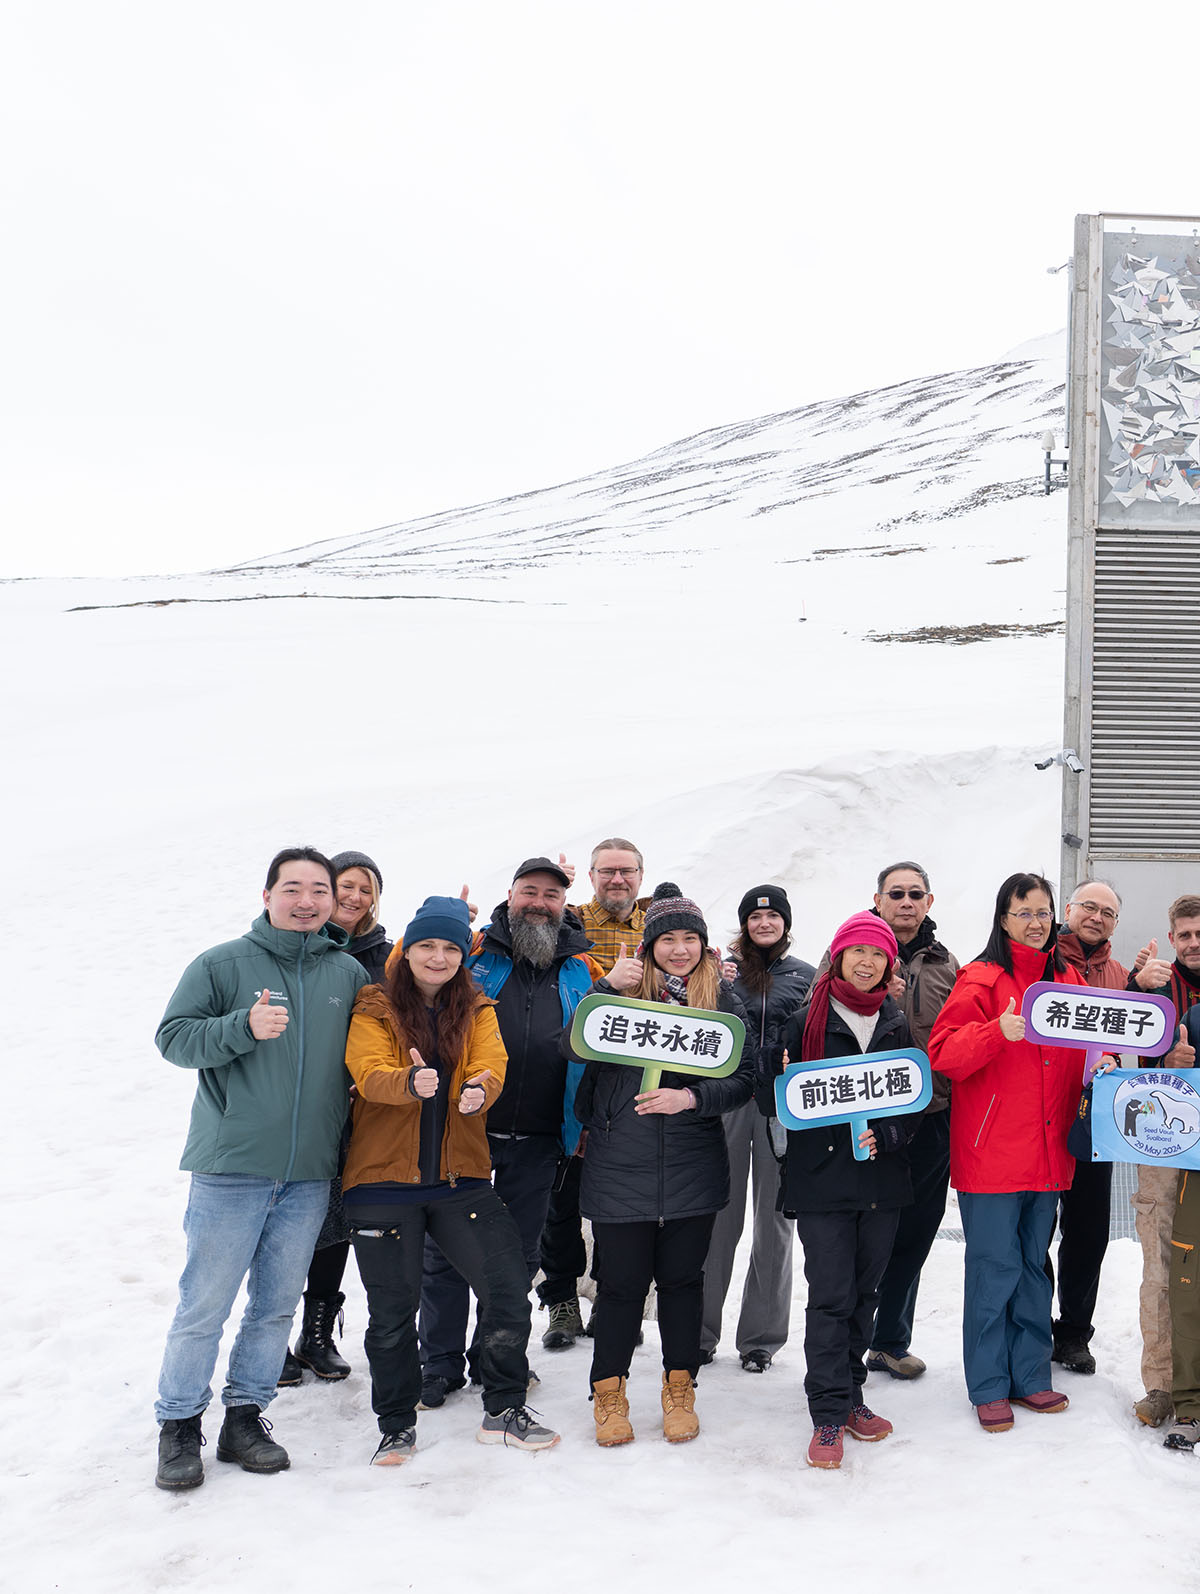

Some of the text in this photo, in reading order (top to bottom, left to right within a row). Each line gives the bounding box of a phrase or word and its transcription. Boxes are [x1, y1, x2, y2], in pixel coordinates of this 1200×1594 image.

[1046, 1000, 1155, 1037] 希望種子
[599, 1014, 723, 1059] 追求永續
[799, 1066, 912, 1110] 前進北極
[1144, 1126, 1175, 1136] Seed Vault
[1146, 1134, 1172, 1143] Svalbard
[1134, 1140, 1182, 1156] 29 May 2024
